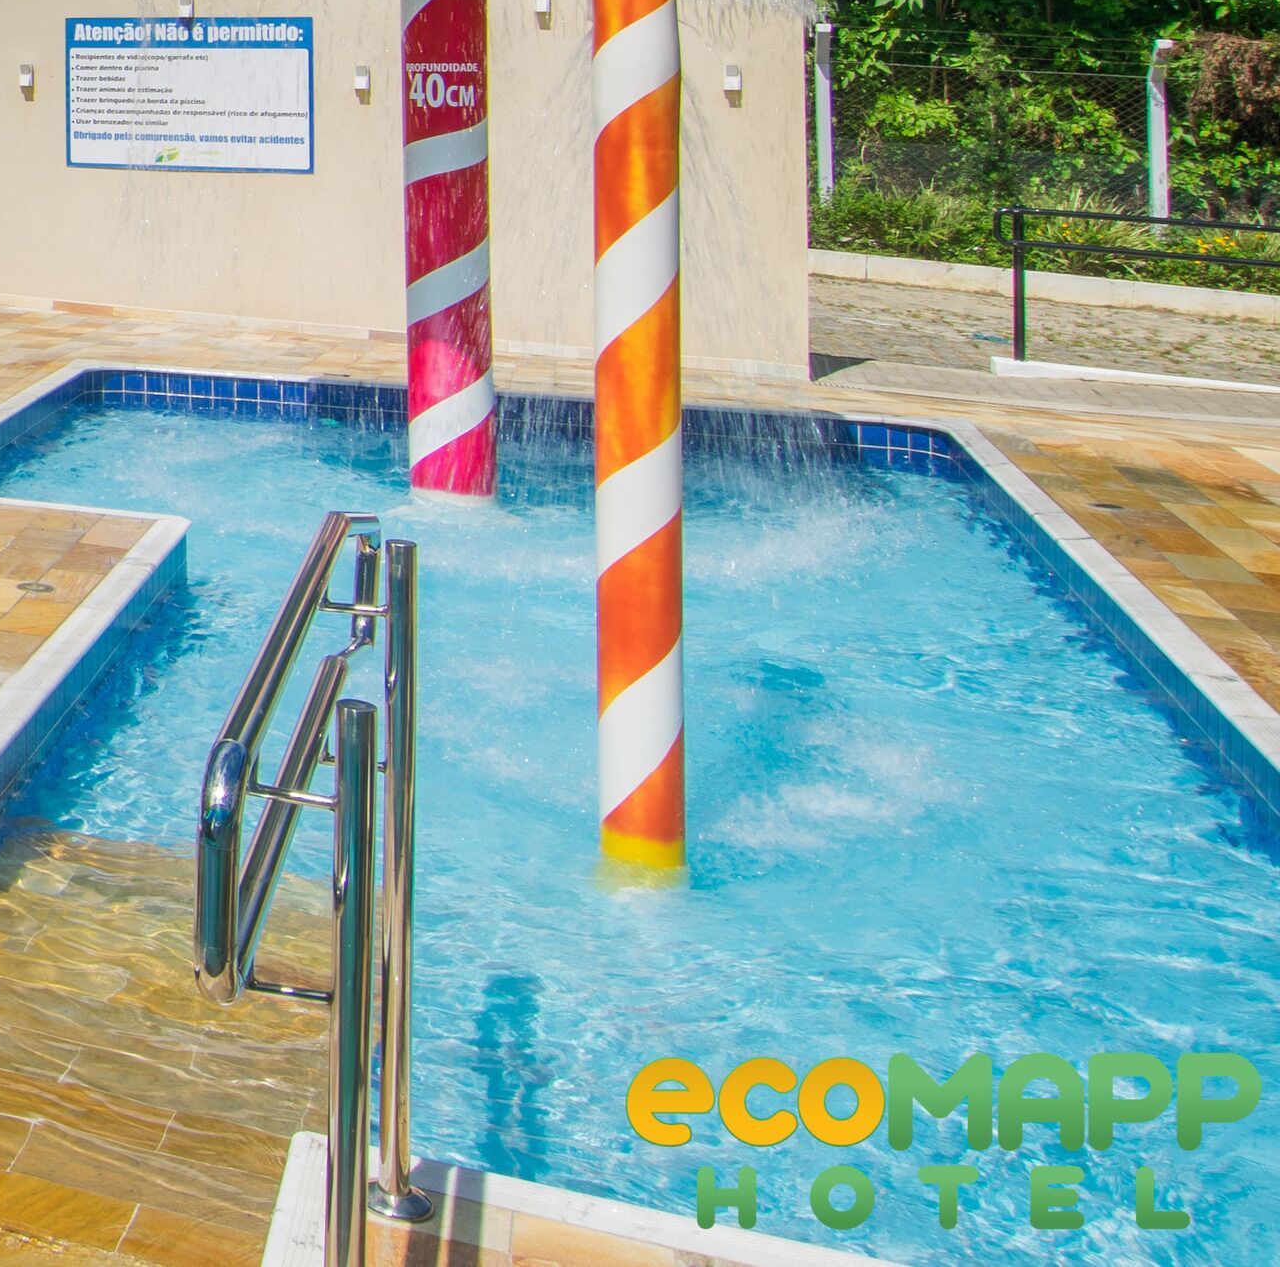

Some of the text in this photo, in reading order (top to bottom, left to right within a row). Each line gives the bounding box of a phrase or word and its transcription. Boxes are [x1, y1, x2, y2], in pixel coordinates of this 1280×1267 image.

[74, 23, 304, 44] Atenção! Não é permitido:
[75, 53, 115, 62] Recipientes
[406, 63, 478, 72] PROFUNDIDADE
[409, 73, 474, 108] 40CM
[180, 98, 206, 107] piscina
[76, 108, 105, 116] Crianças
[106, 108, 171, 117] desacompanhadas
[183, 109, 226, 118] responsável
[73, 131, 113, 141] Obrigado
[199, 135, 229, 143] vamos
[230, 134, 257, 144] evitar
[258, 134, 305, 145] acidentes
